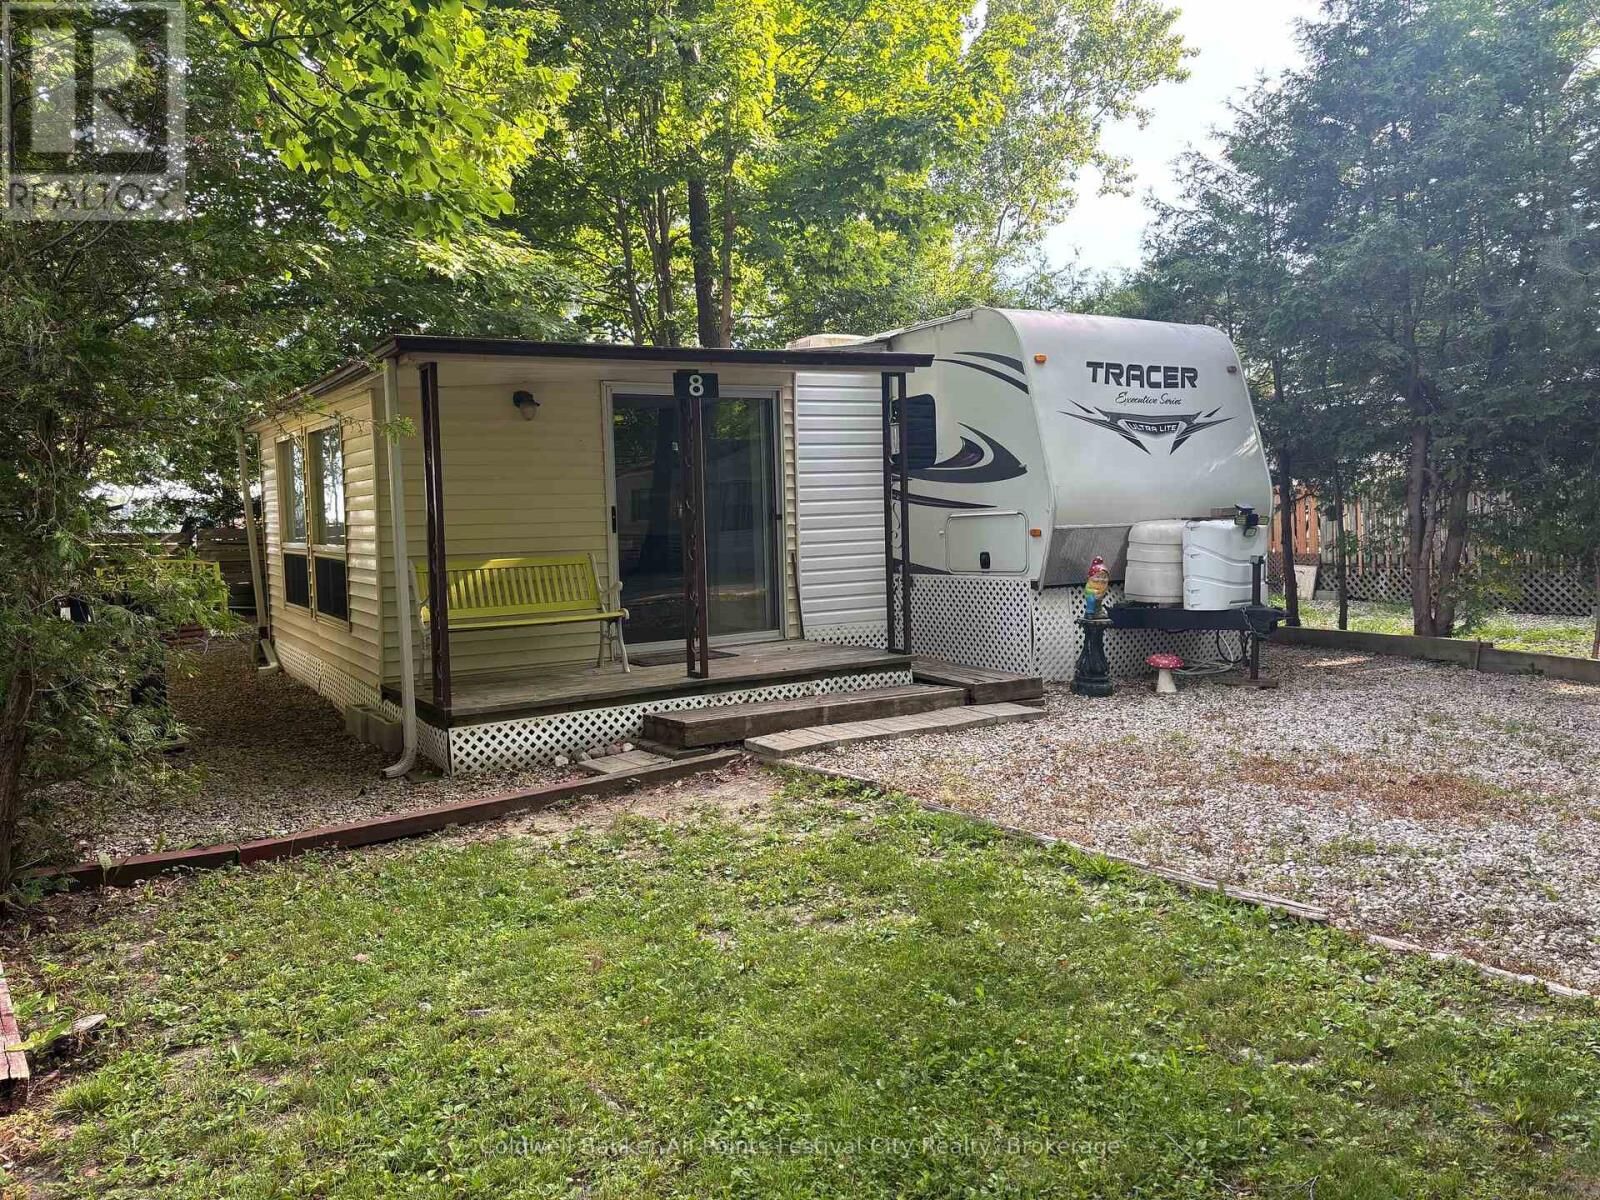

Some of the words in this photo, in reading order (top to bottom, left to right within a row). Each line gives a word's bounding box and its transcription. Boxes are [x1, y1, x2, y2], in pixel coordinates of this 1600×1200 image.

[1086, 361, 1198, 388] TRACER
[689, 374, 704, 396] 8
[1115, 391, 1158, 407] Executive
[1159, 393, 1181, 405] Series
[1128, 423, 1157, 432] ULTRA
[1160, 424, 1177, 432] LITE
